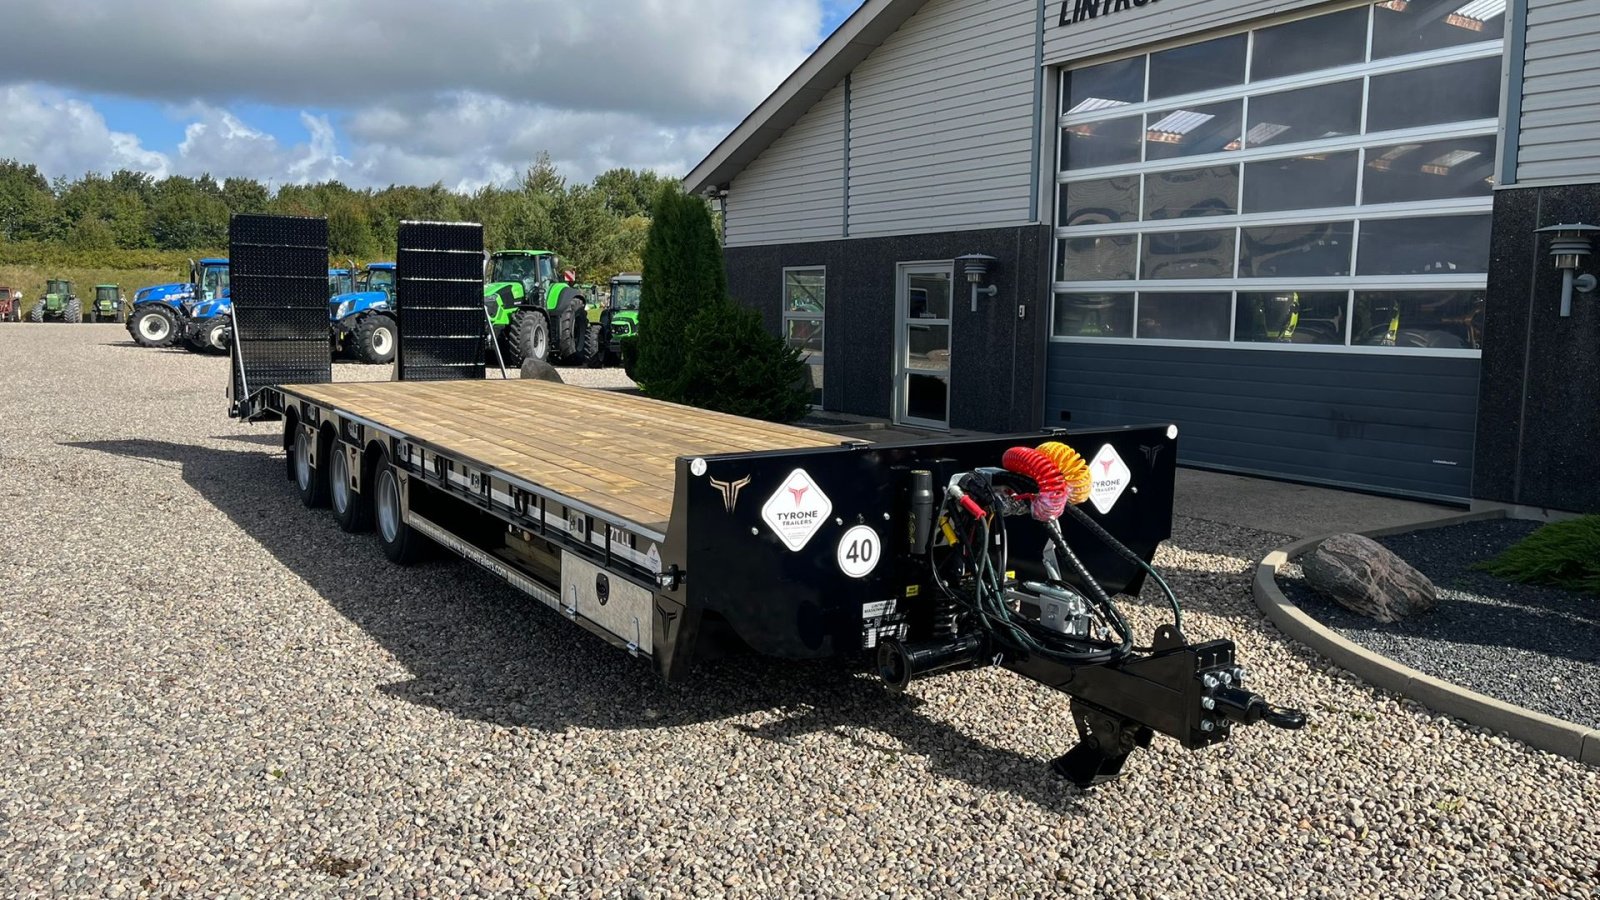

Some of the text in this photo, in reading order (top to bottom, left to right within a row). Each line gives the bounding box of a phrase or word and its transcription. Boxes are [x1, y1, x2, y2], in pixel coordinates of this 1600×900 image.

[1058, 0, 1161, 27] LINT
[776, 510, 818, 521] TYRONE
[782, 519, 812, 527] TRAILERS
[846, 538, 873, 564] 40
